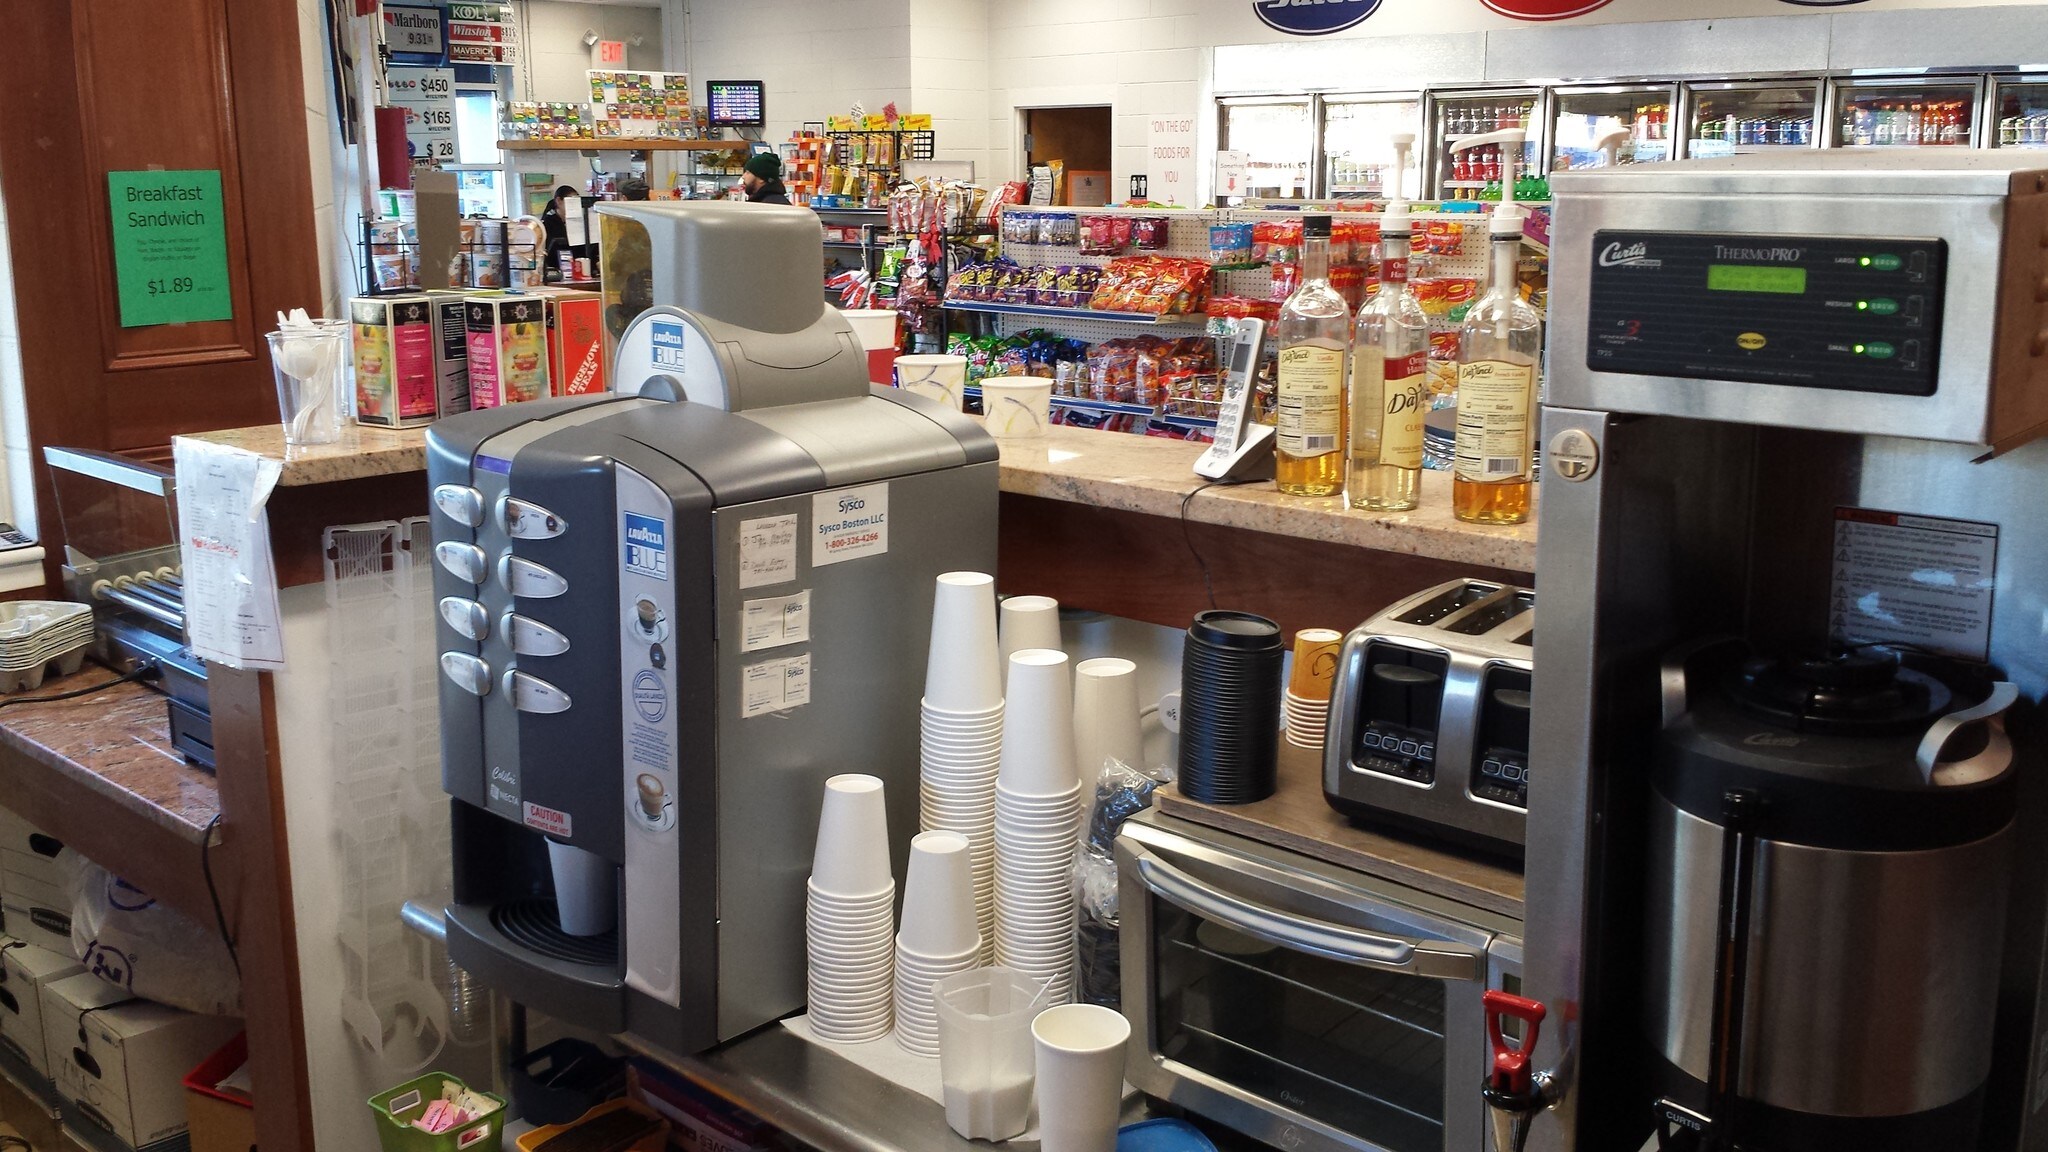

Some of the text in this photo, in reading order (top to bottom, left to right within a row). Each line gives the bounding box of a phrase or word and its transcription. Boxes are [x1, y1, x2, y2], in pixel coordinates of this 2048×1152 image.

[453, 6, 483, 19] KOOL
[394, 13, 438, 29] Marlboro
[453, 25, 491, 36] Winston
[453, 47, 494, 56] MAVERICK
[602, 42, 622, 62] EXIT
[421, 78, 448, 92] $450
[424, 111, 451, 124] $165
[1167, 121, 1178, 132] THE
[439, 143, 453, 155] 28
[1154, 147, 1190, 158] FOODS FOR
[1164, 171, 1178, 182] YOU
[127, 186, 203, 202] Breakfast
[128, 210, 205, 227] Sandwich
[1599, 242, 1646, 267] Curtis
[148, 277, 193, 297] $1.89
[567, 340, 600, 395] BIGELOW
[577, 361, 598, 393] TEAS
[839, 499, 865, 514] Sysco
[819, 524, 841, 536] Sysco
[842, 518, 869, 530] Boston
[870, 513, 885, 525] LLC
[628, 527, 663, 546] LAVAZZA
[825, 532, 879, 550] 1-800-326-4266
[627, 545, 667, 573] BLUE
[786, 604, 803, 614] Sysco
[787, 668, 804, 679] Sysco
[530, 805, 564, 825] CAUTION
[1665, 1110, 1702, 1131] CURTIS
